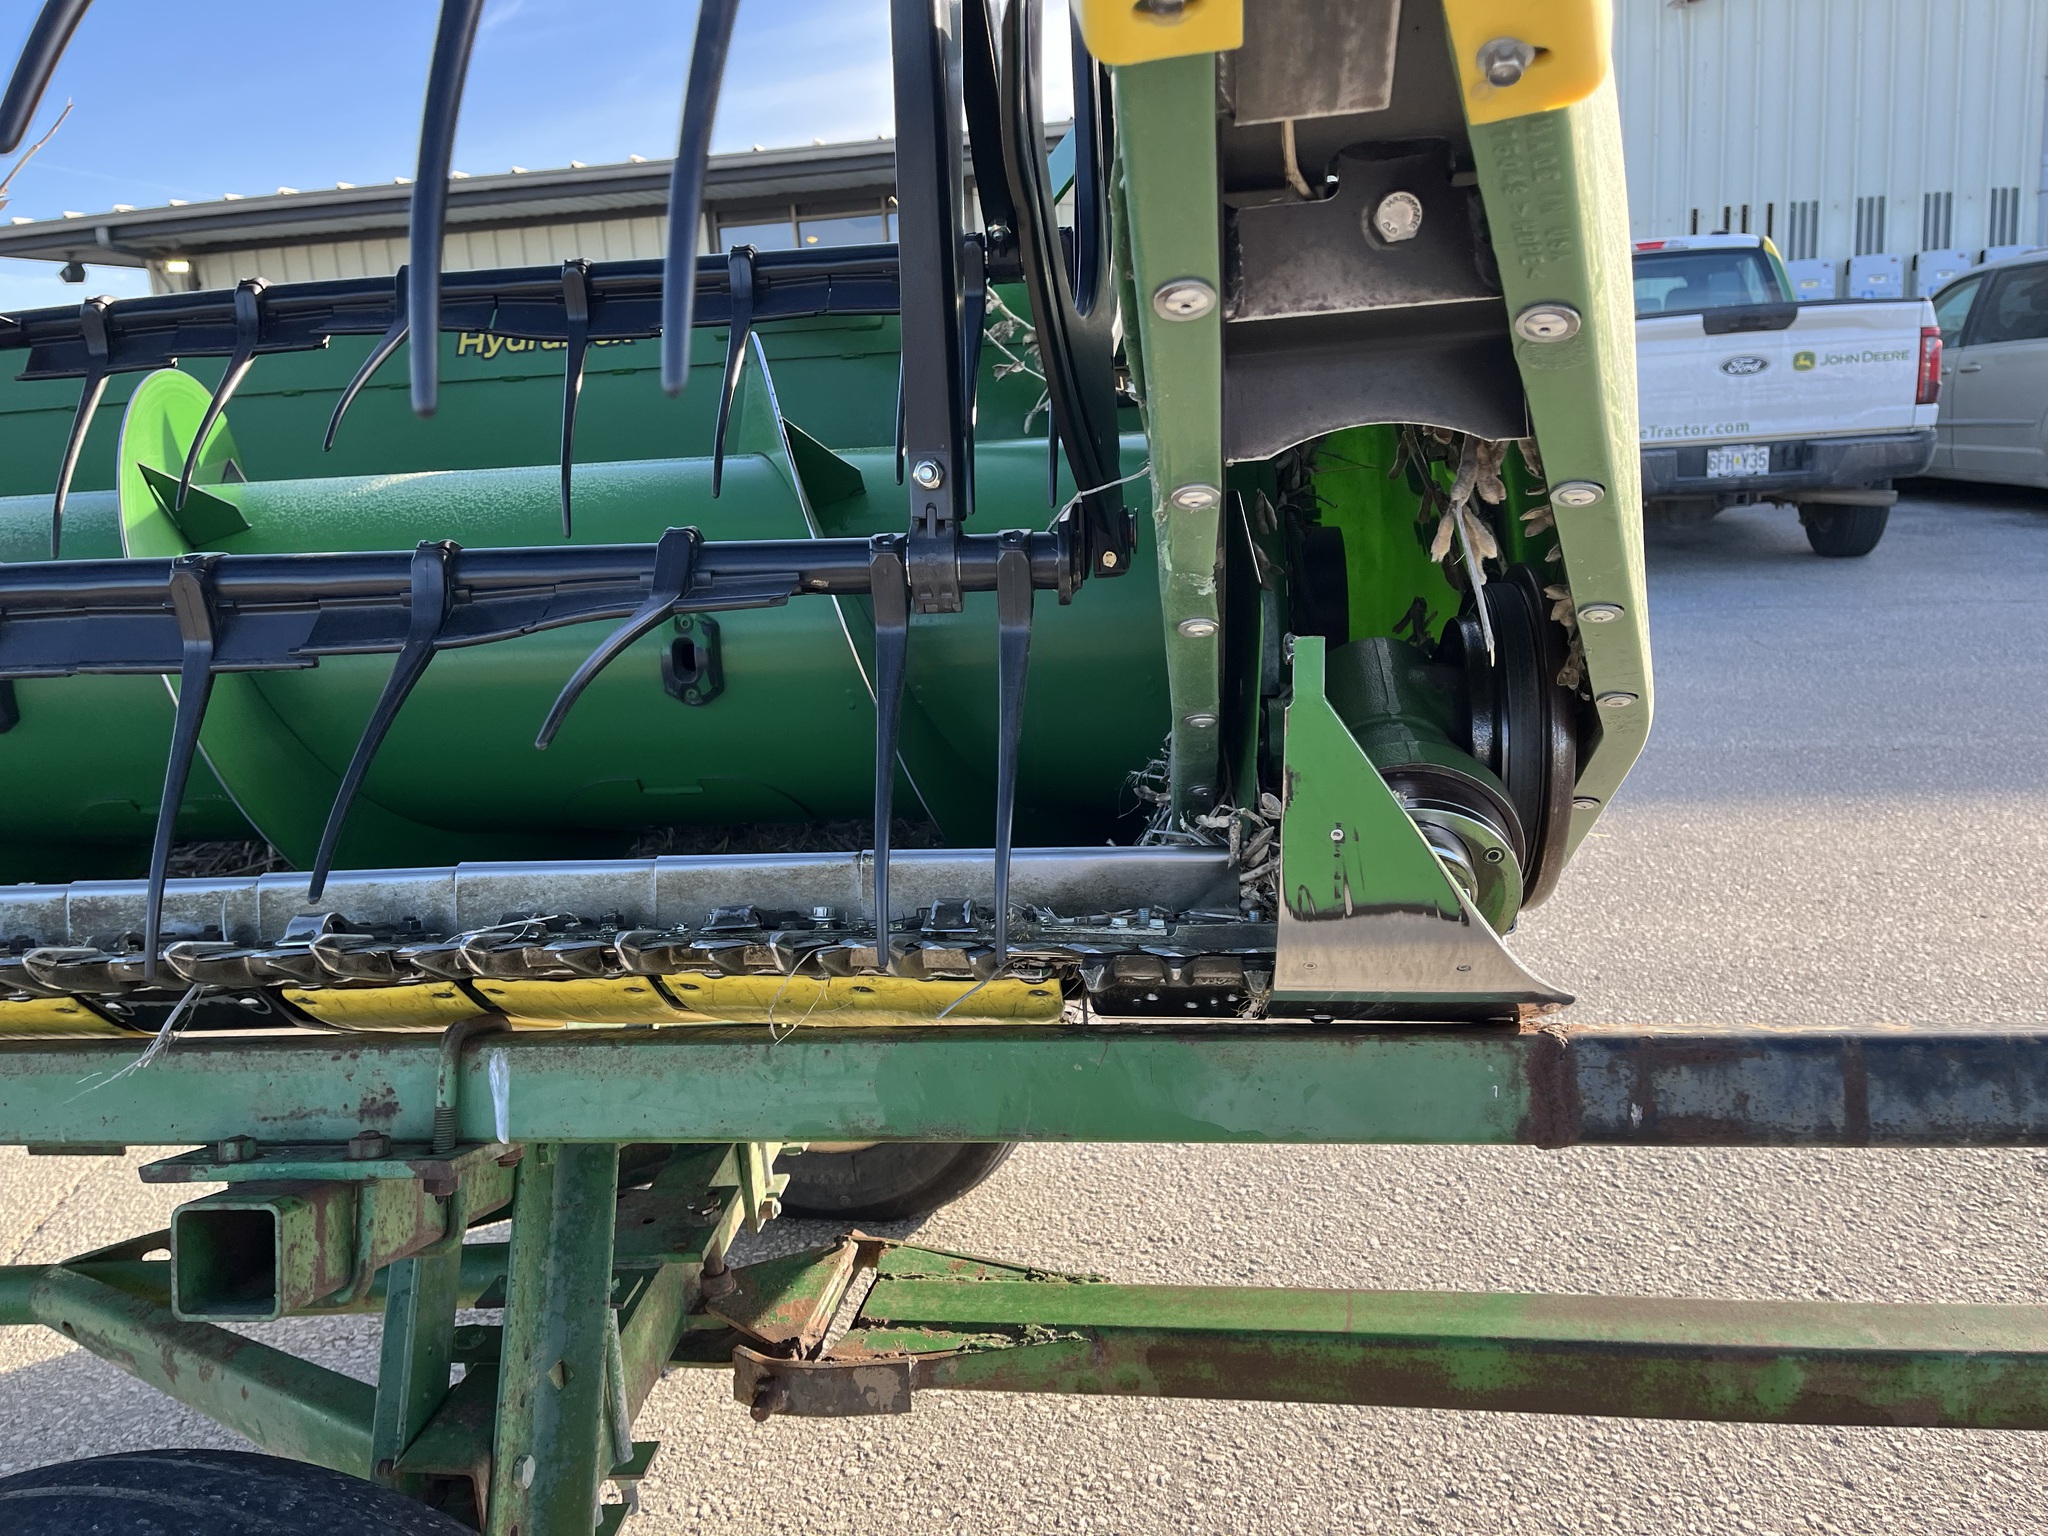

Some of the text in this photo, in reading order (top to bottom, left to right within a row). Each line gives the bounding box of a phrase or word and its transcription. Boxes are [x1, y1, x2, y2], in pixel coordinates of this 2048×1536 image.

[1728, 357, 1761, 374] Ford
[1820, 349, 1910, 366] JOHN DEERE
